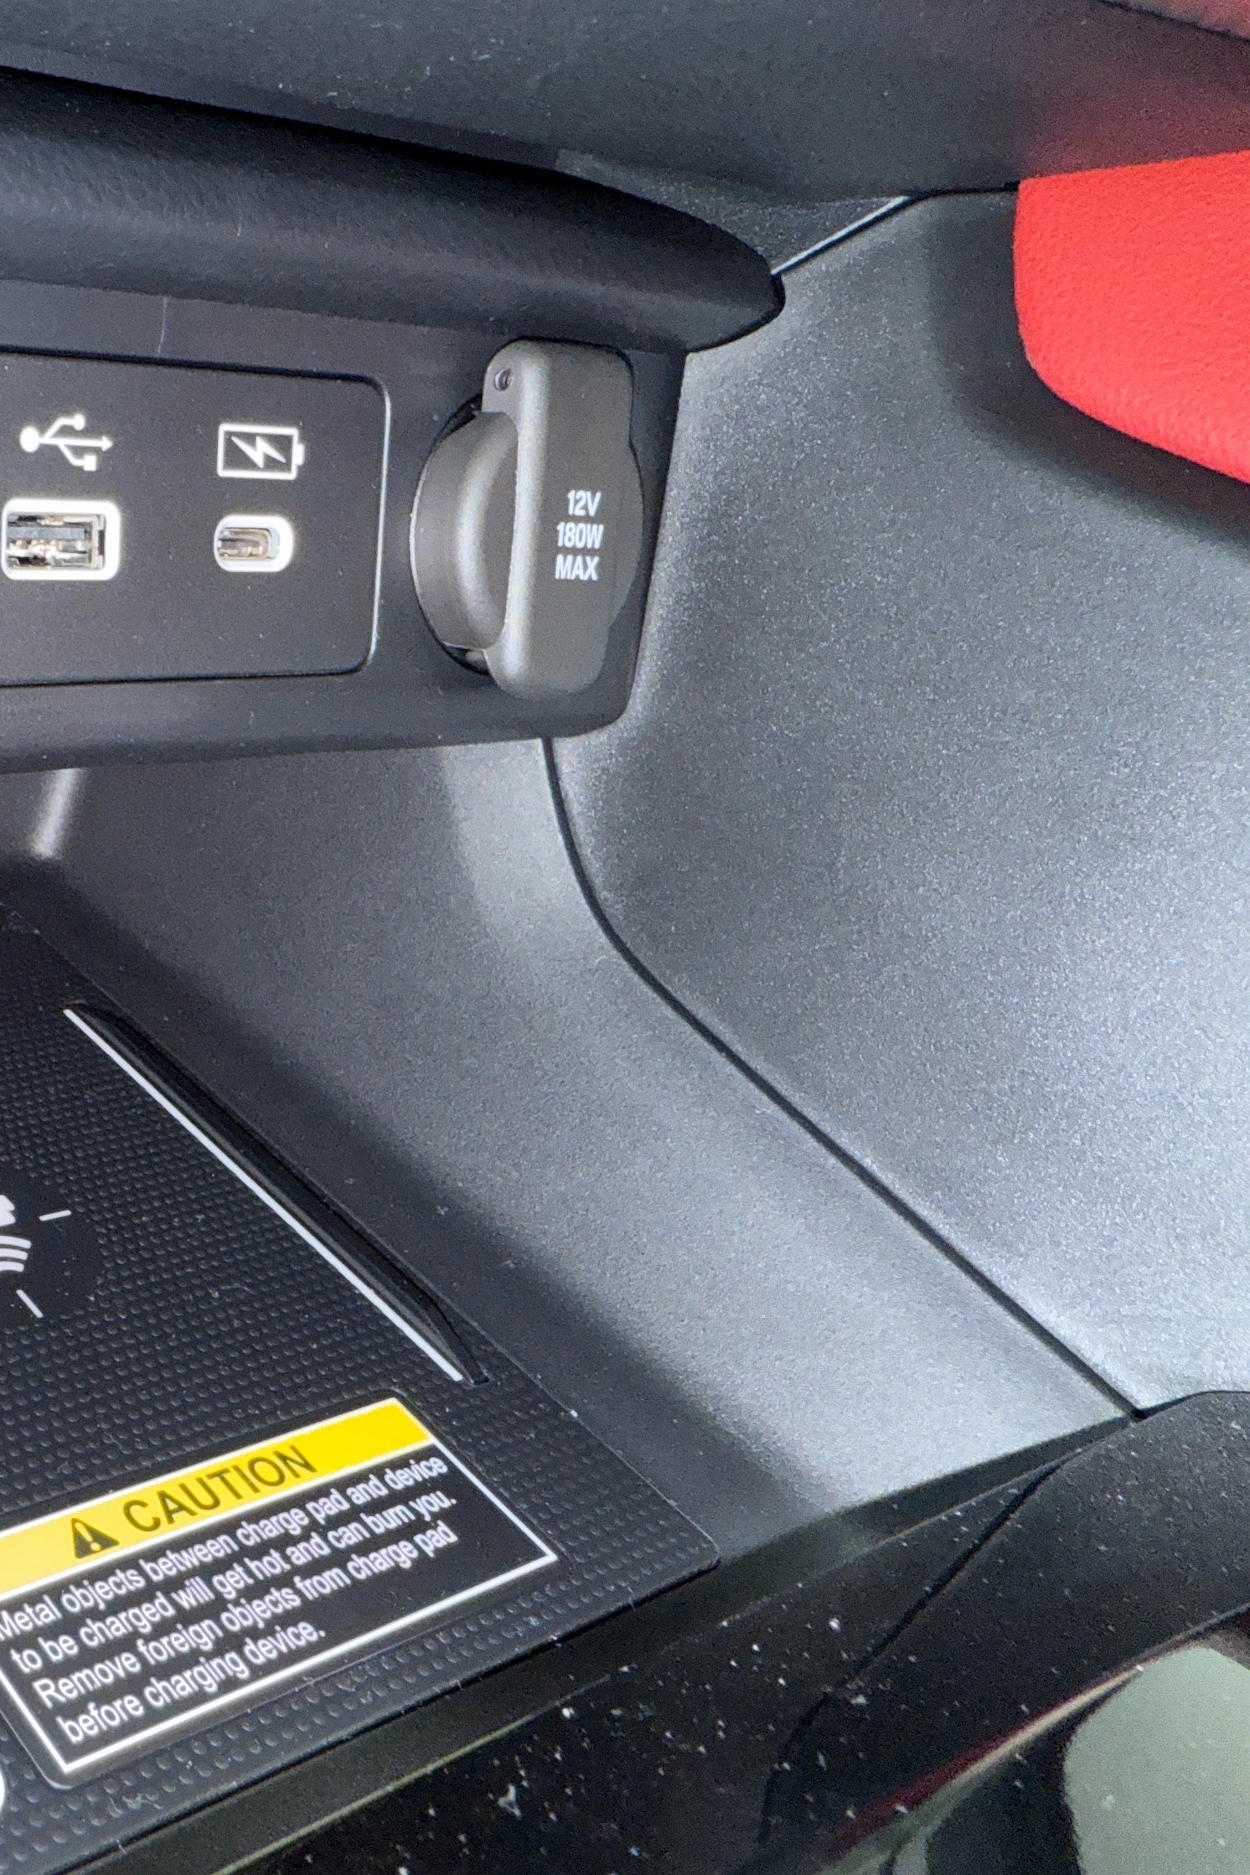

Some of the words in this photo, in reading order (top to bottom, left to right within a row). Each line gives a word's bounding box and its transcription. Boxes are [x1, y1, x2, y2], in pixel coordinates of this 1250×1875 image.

[556, 521, 604, 549] 180W
[566, 489, 601, 517] 12V
[555, 554, 599, 581] MAX
[62, 1567, 145, 1611] objects
[139, 1533, 237, 1583] between
[236, 1507, 307, 1547] charge
[305, 1488, 351, 1525] pad
[345, 1474, 389, 1506] and
[384, 1456, 448, 1491] device
[123, 1445, 317, 1532] CAUTION
[10, 1649, 43, 1675] to
[38, 1634, 79, 1663] be
[79, 1591, 175, 1648] charged
[171, 1576, 216, 1611] will
[212, 1563, 253, 1600] get
[244, 1547, 291, 1582] hot
[285, 1532, 331, 1566] and
[327, 1521, 370, 1549] can
[360, 1503, 416, 1534] burn
[412, 1491, 458, 1522] you.
[32, 1651, 142, 1709] Remove
[138, 1618, 224, 1666] foreign
[220, 1587, 302, 1633] objects
[293, 1565, 350, 1602] from
[346, 1539, 416, 1580] charge
[414, 1520, 458, 1558] pad
[56, 1694, 144, 1744] before
[143, 1650, 250, 1708] charging
[243, 1618, 326, 1665] device.
